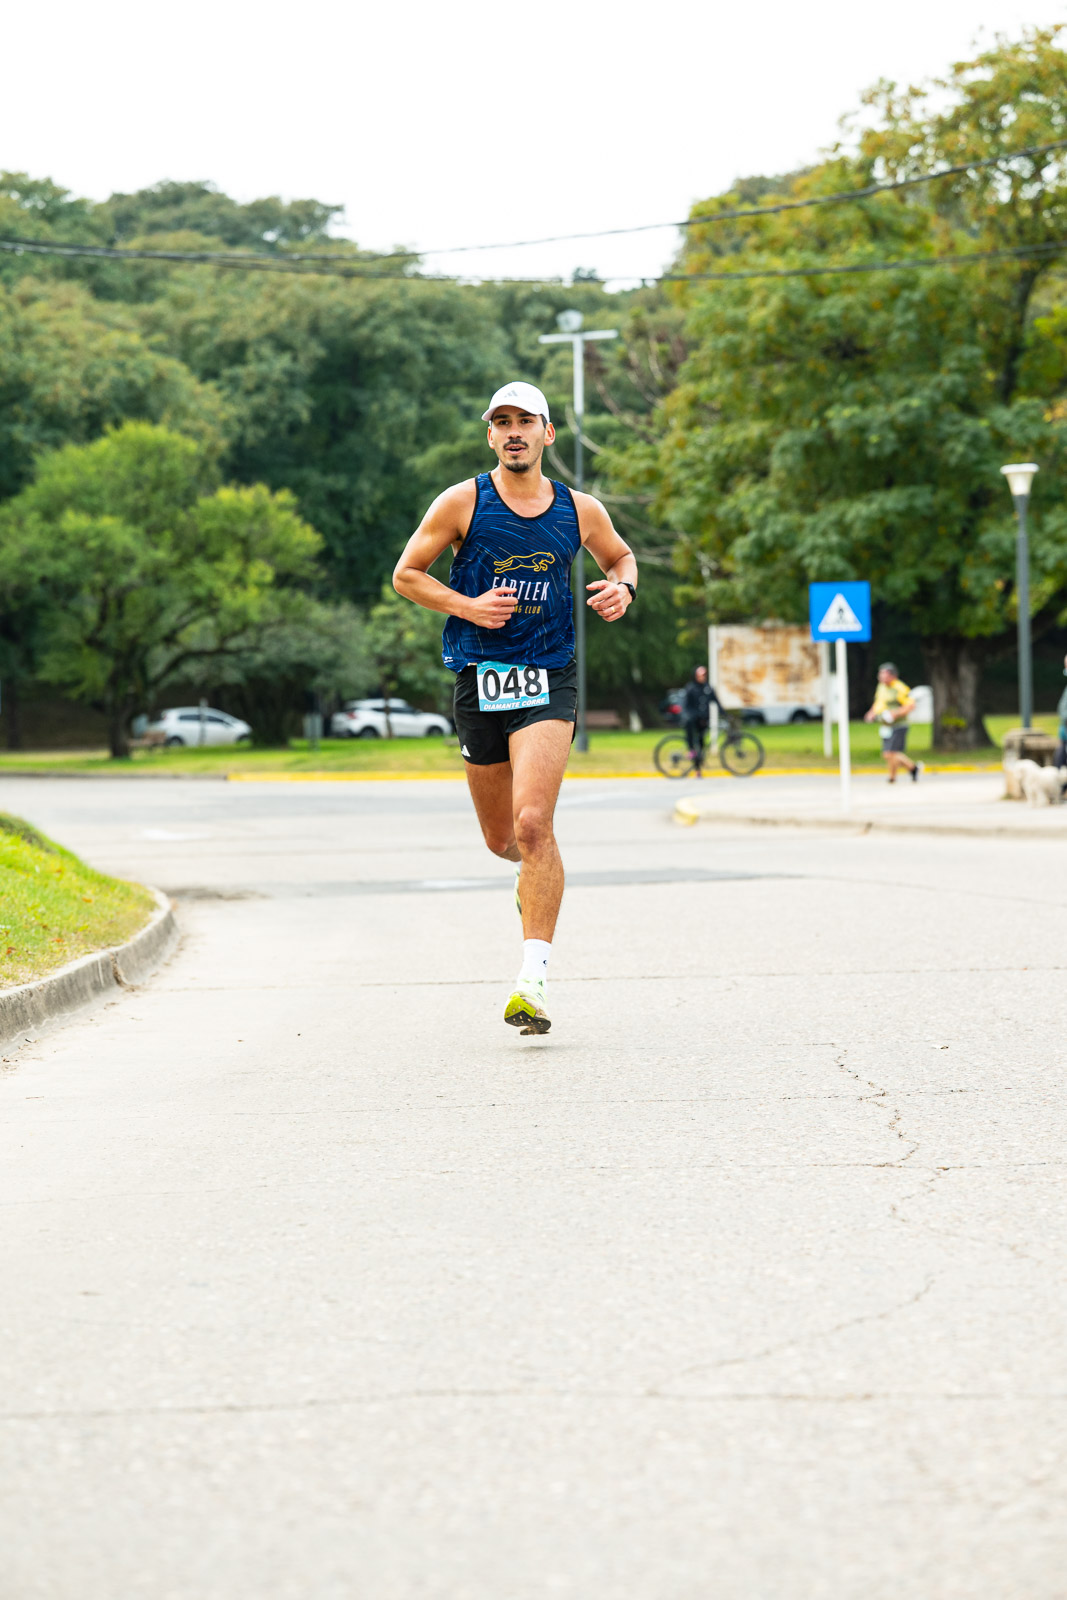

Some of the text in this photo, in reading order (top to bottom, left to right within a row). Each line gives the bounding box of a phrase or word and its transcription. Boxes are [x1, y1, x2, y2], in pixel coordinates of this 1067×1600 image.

[525, 606, 541, 614] CLUB
[483, 667, 542, 702] 048
[484, 697, 546, 710] DIAMANTE CORRE
